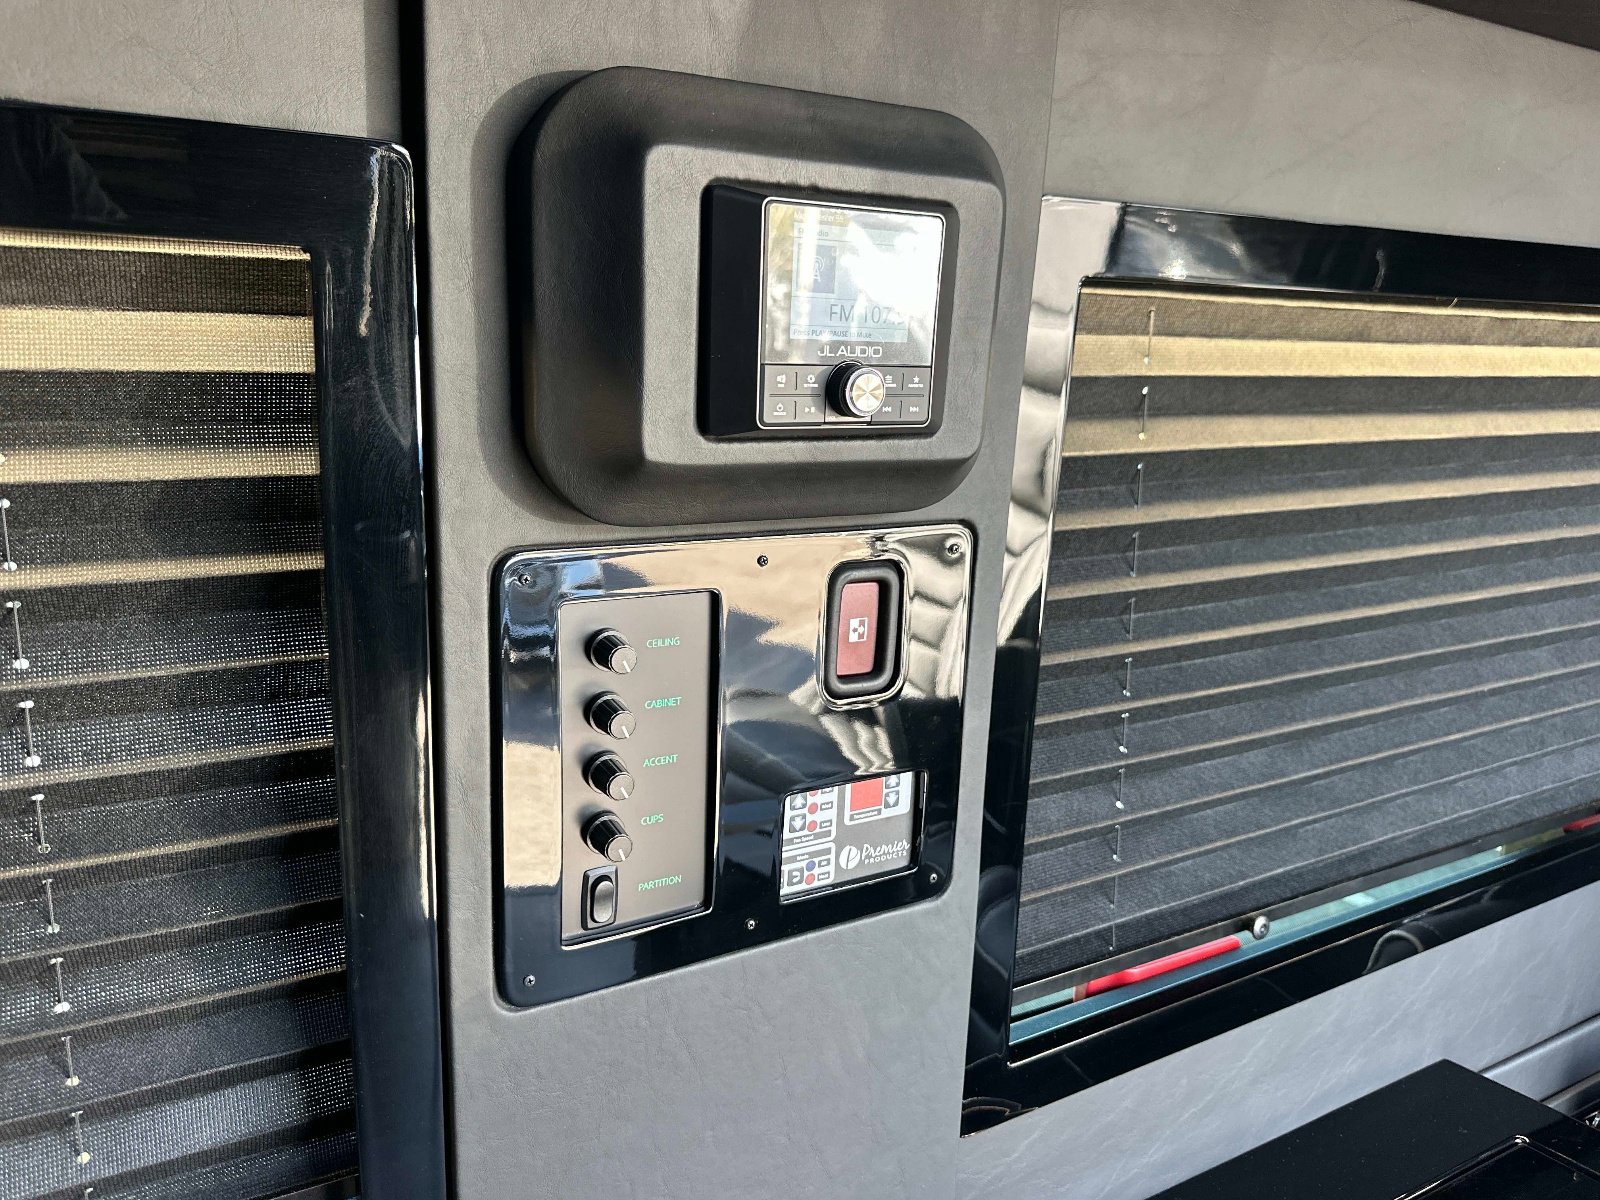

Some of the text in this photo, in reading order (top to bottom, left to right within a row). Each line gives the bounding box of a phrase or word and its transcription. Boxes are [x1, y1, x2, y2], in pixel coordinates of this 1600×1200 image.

[829, 303, 855, 323] FM
[817, 345, 883, 358] JL AUDIO
[646, 636, 681, 648] CEILING
[644, 696, 682, 709] CABINET
[643, 754, 678, 767] ACCENT
[640, 814, 664, 825] CUPS
[861, 839, 910, 860] Premier
[864, 850, 907, 865] PRODUCTS
[638, 875, 682, 891] PARTITION
